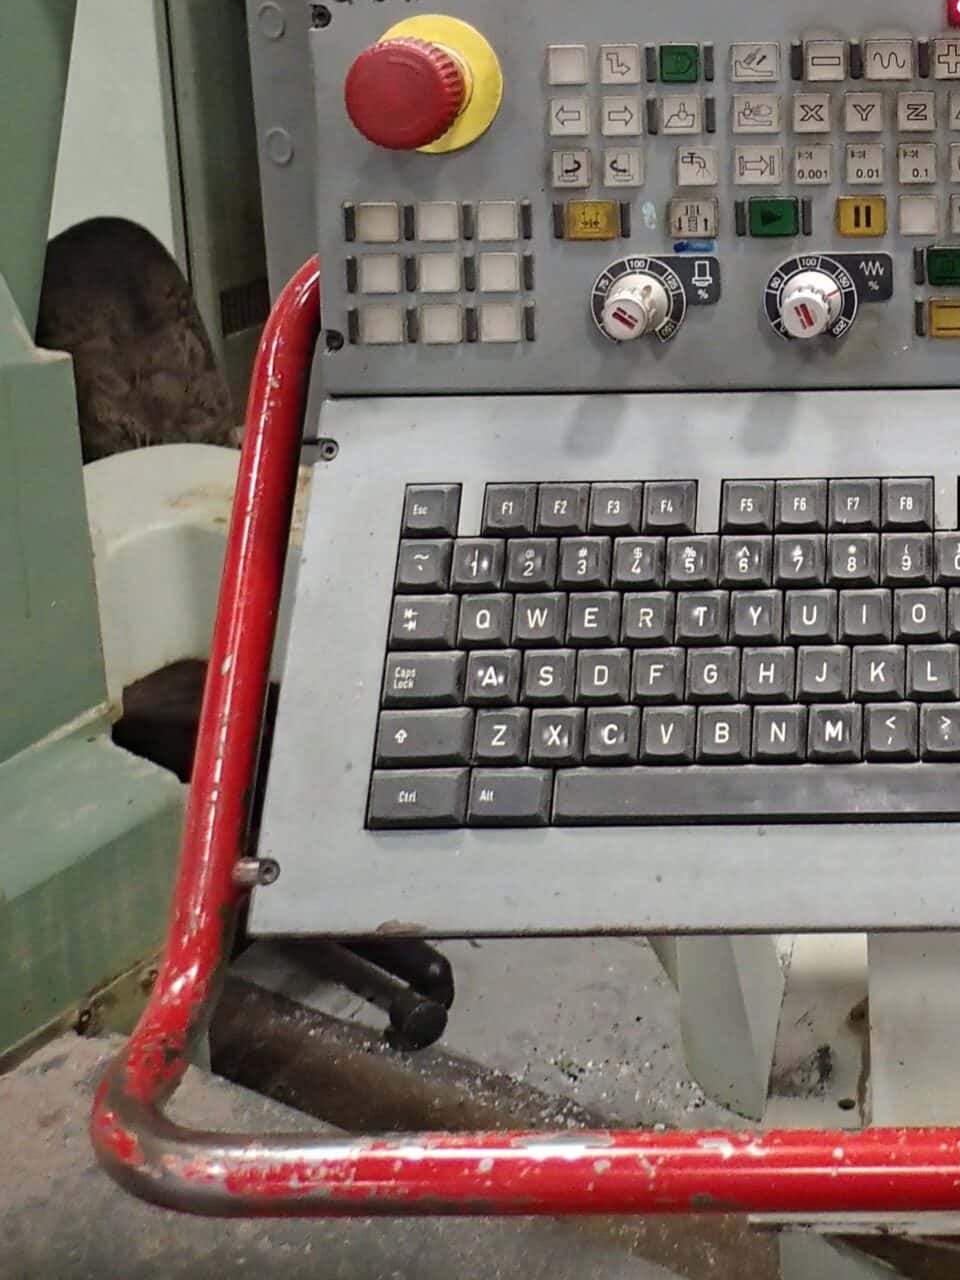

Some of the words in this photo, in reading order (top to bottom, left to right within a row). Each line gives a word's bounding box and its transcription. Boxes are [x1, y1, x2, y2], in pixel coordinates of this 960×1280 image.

[800, 104, 824, 121] X
[853, 104, 875, 120] Y
[907, 104, 927, 120] Z
[798, 171, 828, 179] 0.001
[856, 169, 879, 178] 0.01
[912, 169, 928, 178] 0.1
[502, 502, 513, 513] F1
[554, 501, 567, 513] F2
[608, 501, 619, 513] F3
[661, 500, 672, 512] F4
[741, 499, 752, 511] F5
[794, 498, 806, 511] F6
[848, 497, 859, 509] F7
[901, 496, 912, 509] F8
[476, 611, 490, 628] Q
[528, 608, 547, 627] W
[585, 608, 598, 627] E
[639, 608, 652, 627] R
[695, 607, 708, 626] T
[749, 607, 762, 625] Y
[803, 606, 817, 624] U
[912, 605, 926, 623] O
[481, 666, 498, 686] A
[539, 666, 553, 686] S
[595, 666, 608, 685] D
[649, 665, 663, 685] F
[704, 664, 718, 683] G
[759, 664, 774, 683] H
[816, 663, 827, 682] J
[871, 662, 885, 681] K
[927, 662, 937, 681] L
[493, 726, 506, 745] Z
[548, 725, 562, 745] X
[604, 725, 618, 744] C
[661, 724, 673, 743] V
[716, 723, 728, 742] B
[771, 722, 785, 741] N
[826, 722, 842, 741] M
[399, 791, 416, 802] Ctrl
[480, 790, 493, 802] Alt
